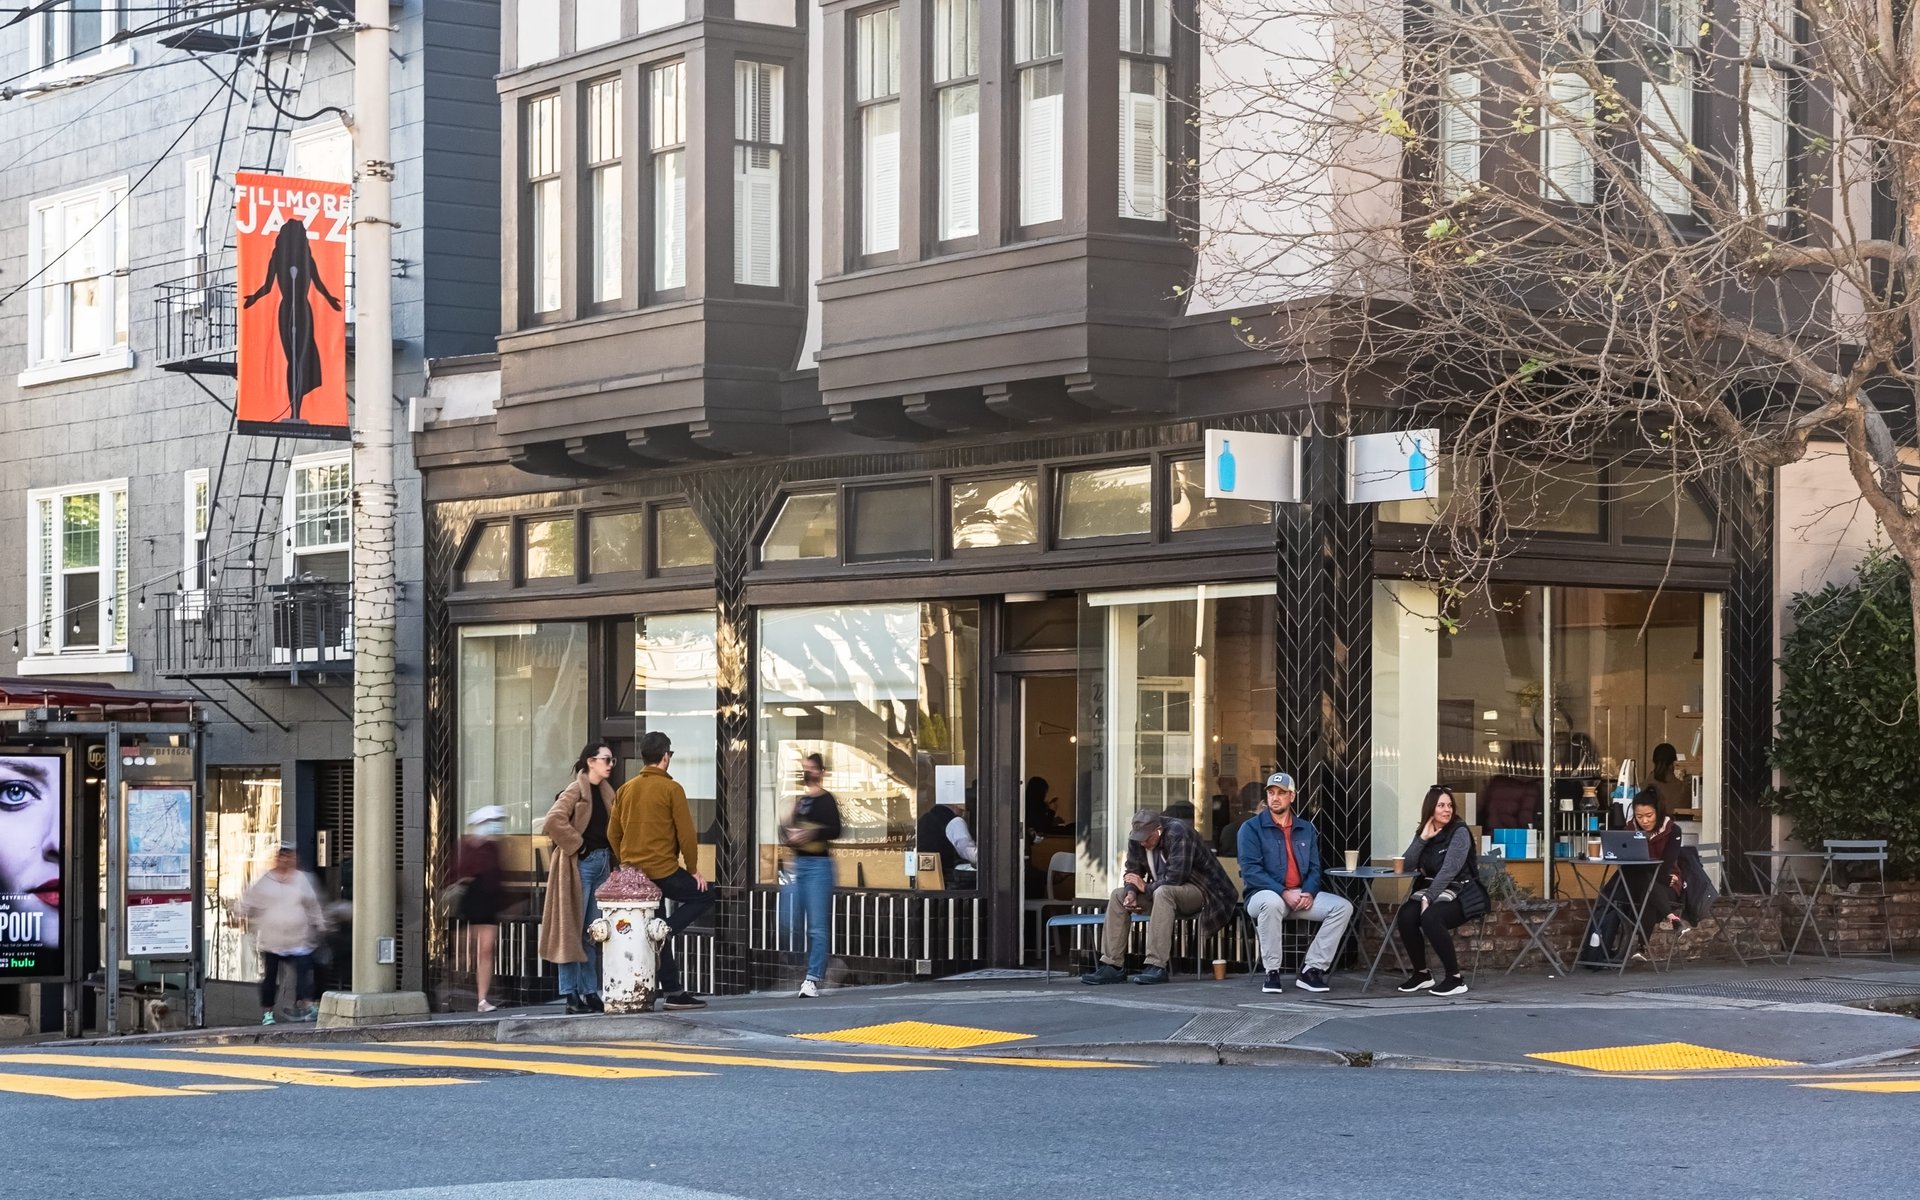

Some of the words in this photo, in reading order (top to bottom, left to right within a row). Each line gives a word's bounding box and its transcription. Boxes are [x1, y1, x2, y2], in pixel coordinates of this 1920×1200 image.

[235, 184, 350, 214] FILLMORE
[236, 202, 348, 243] JAZZ
[140, 896, 153, 905] info
[0, 911, 44, 942] POUT
[11, 957, 35, 968] hulu
